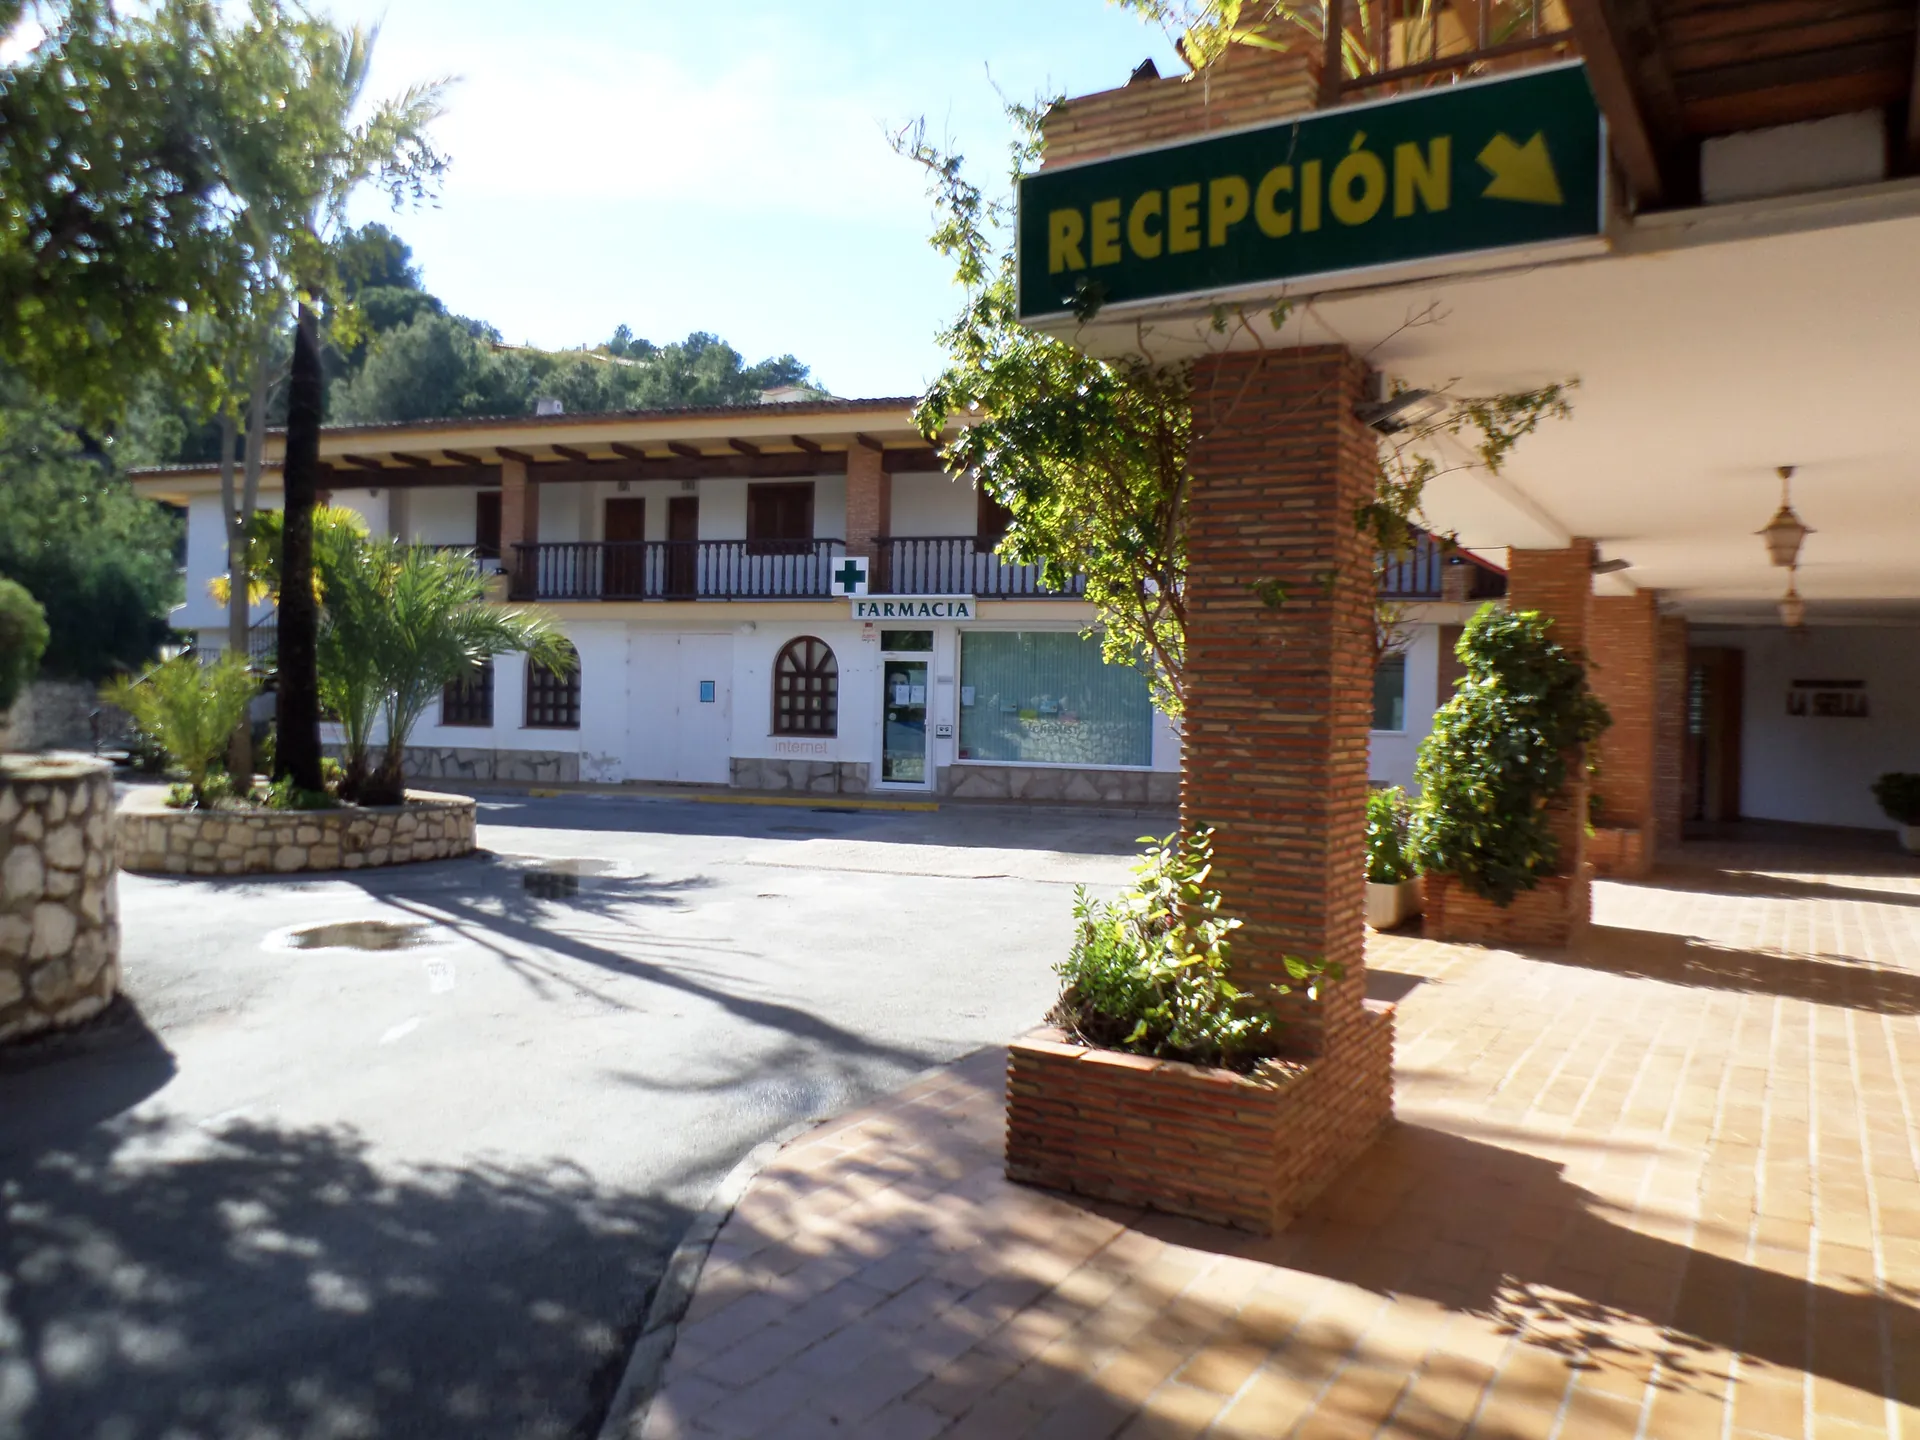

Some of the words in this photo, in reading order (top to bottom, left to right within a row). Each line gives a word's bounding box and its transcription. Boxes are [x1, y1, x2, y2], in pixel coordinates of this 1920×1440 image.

[1048, 131, 1452, 275] RECEPCIÓN
[858, 602, 969, 617] FARMACIA
[774, 740, 828, 754] internet
